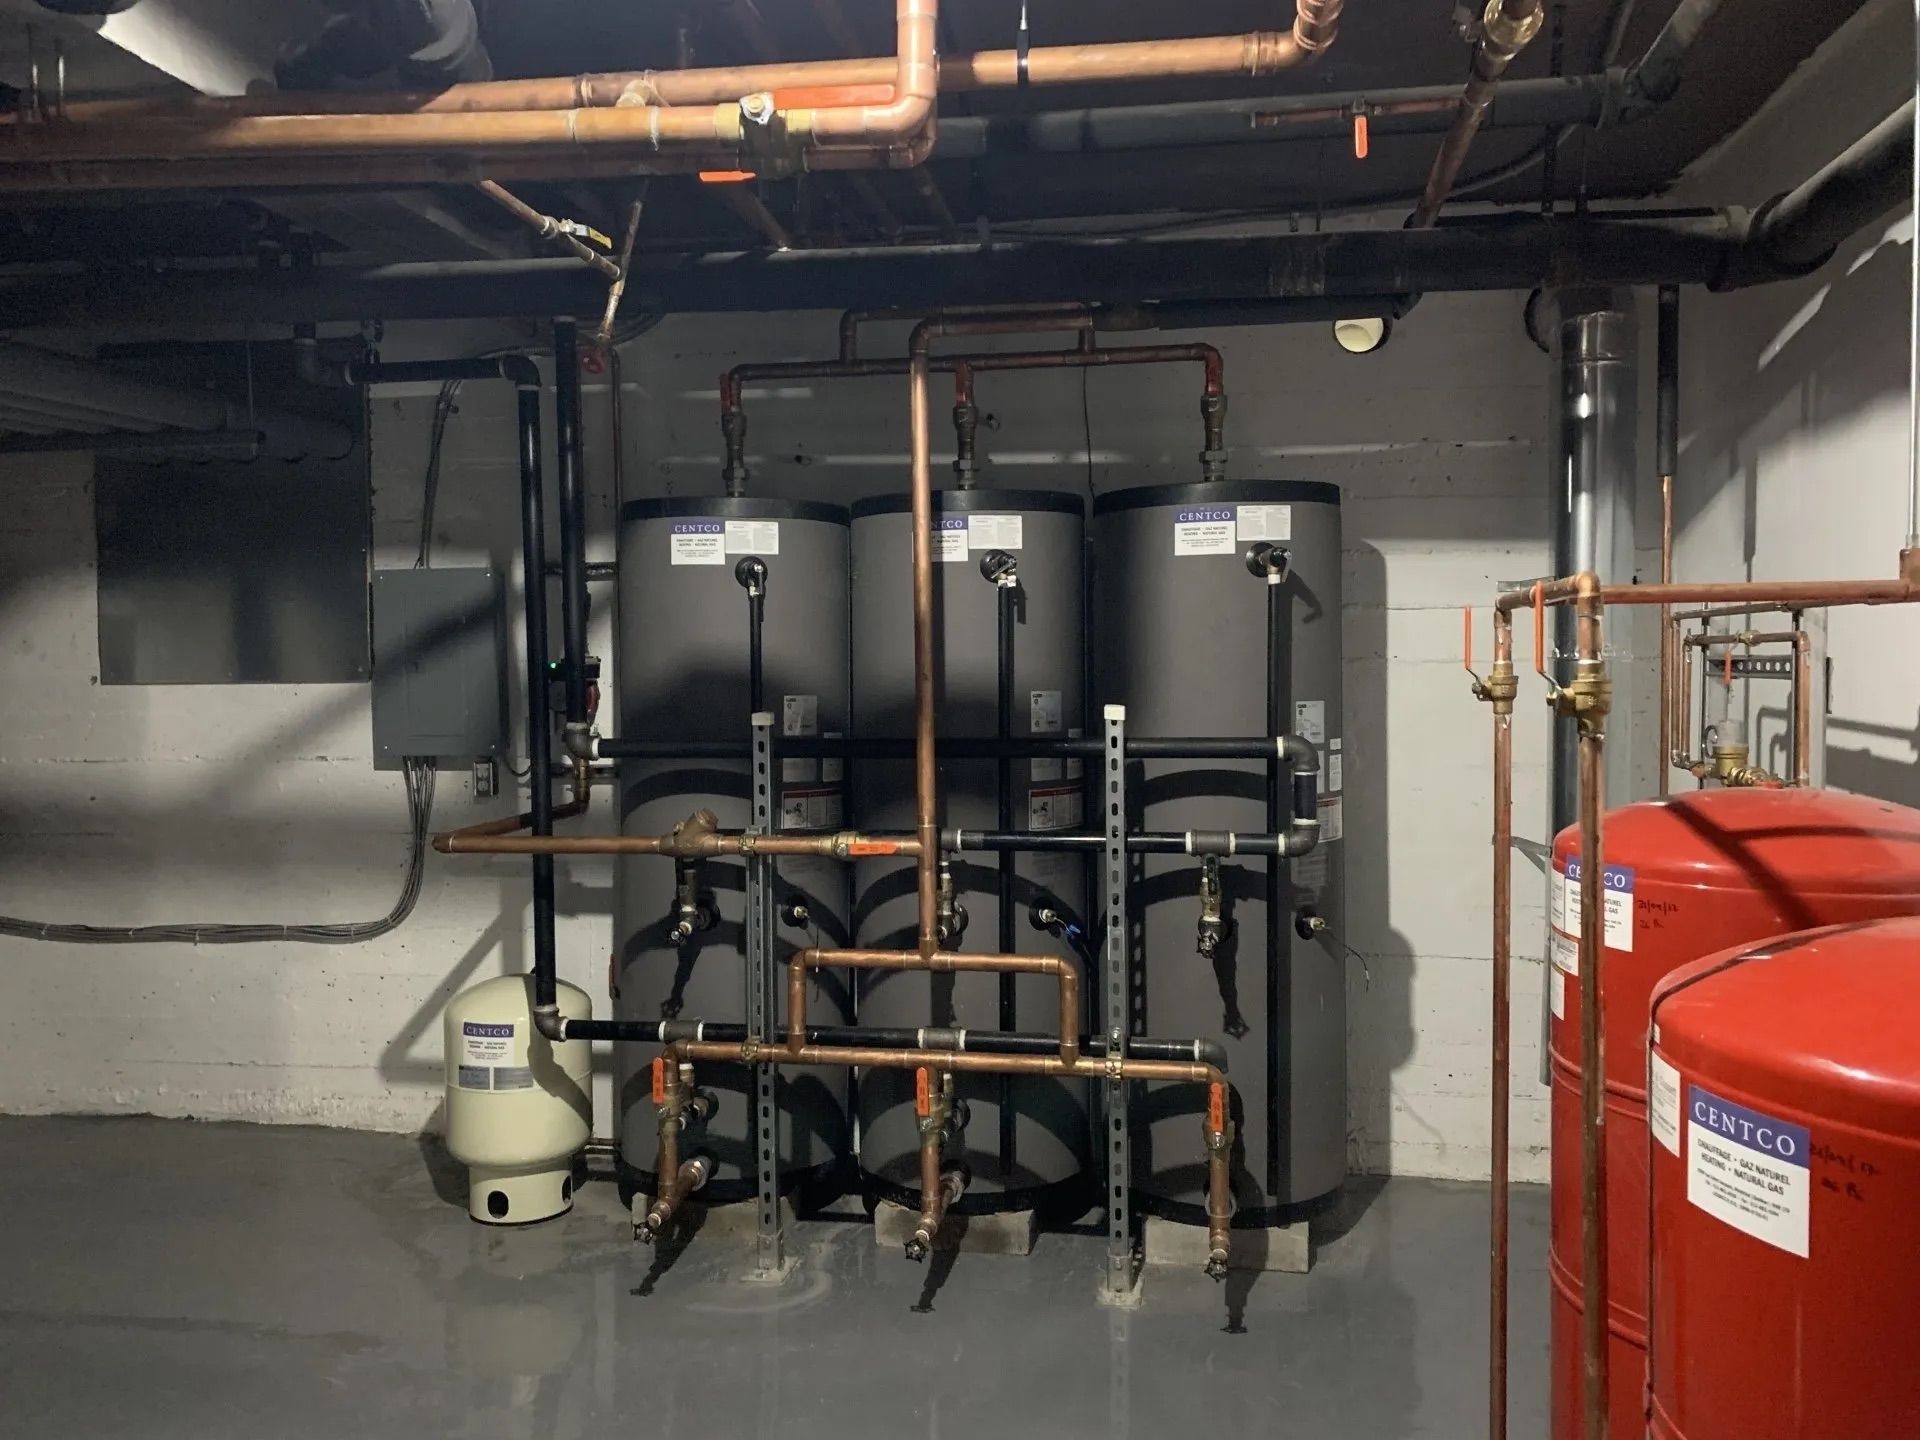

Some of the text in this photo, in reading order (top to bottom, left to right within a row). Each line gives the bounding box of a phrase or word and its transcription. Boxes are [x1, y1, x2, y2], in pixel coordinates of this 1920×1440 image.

[1179, 511, 1231, 521] CENTCO
[674, 524, 720, 533] CENTCO
[466, 1025, 510, 1036] CENTCO
[1694, 1101, 1796, 1156] CENTCO
[1701, 1152, 1785, 1196] HEATING NATURAL GAS
[1740, 1158, 1754, 1172] GAZ
[1755, 1164, 1791, 1186] NATUREL
